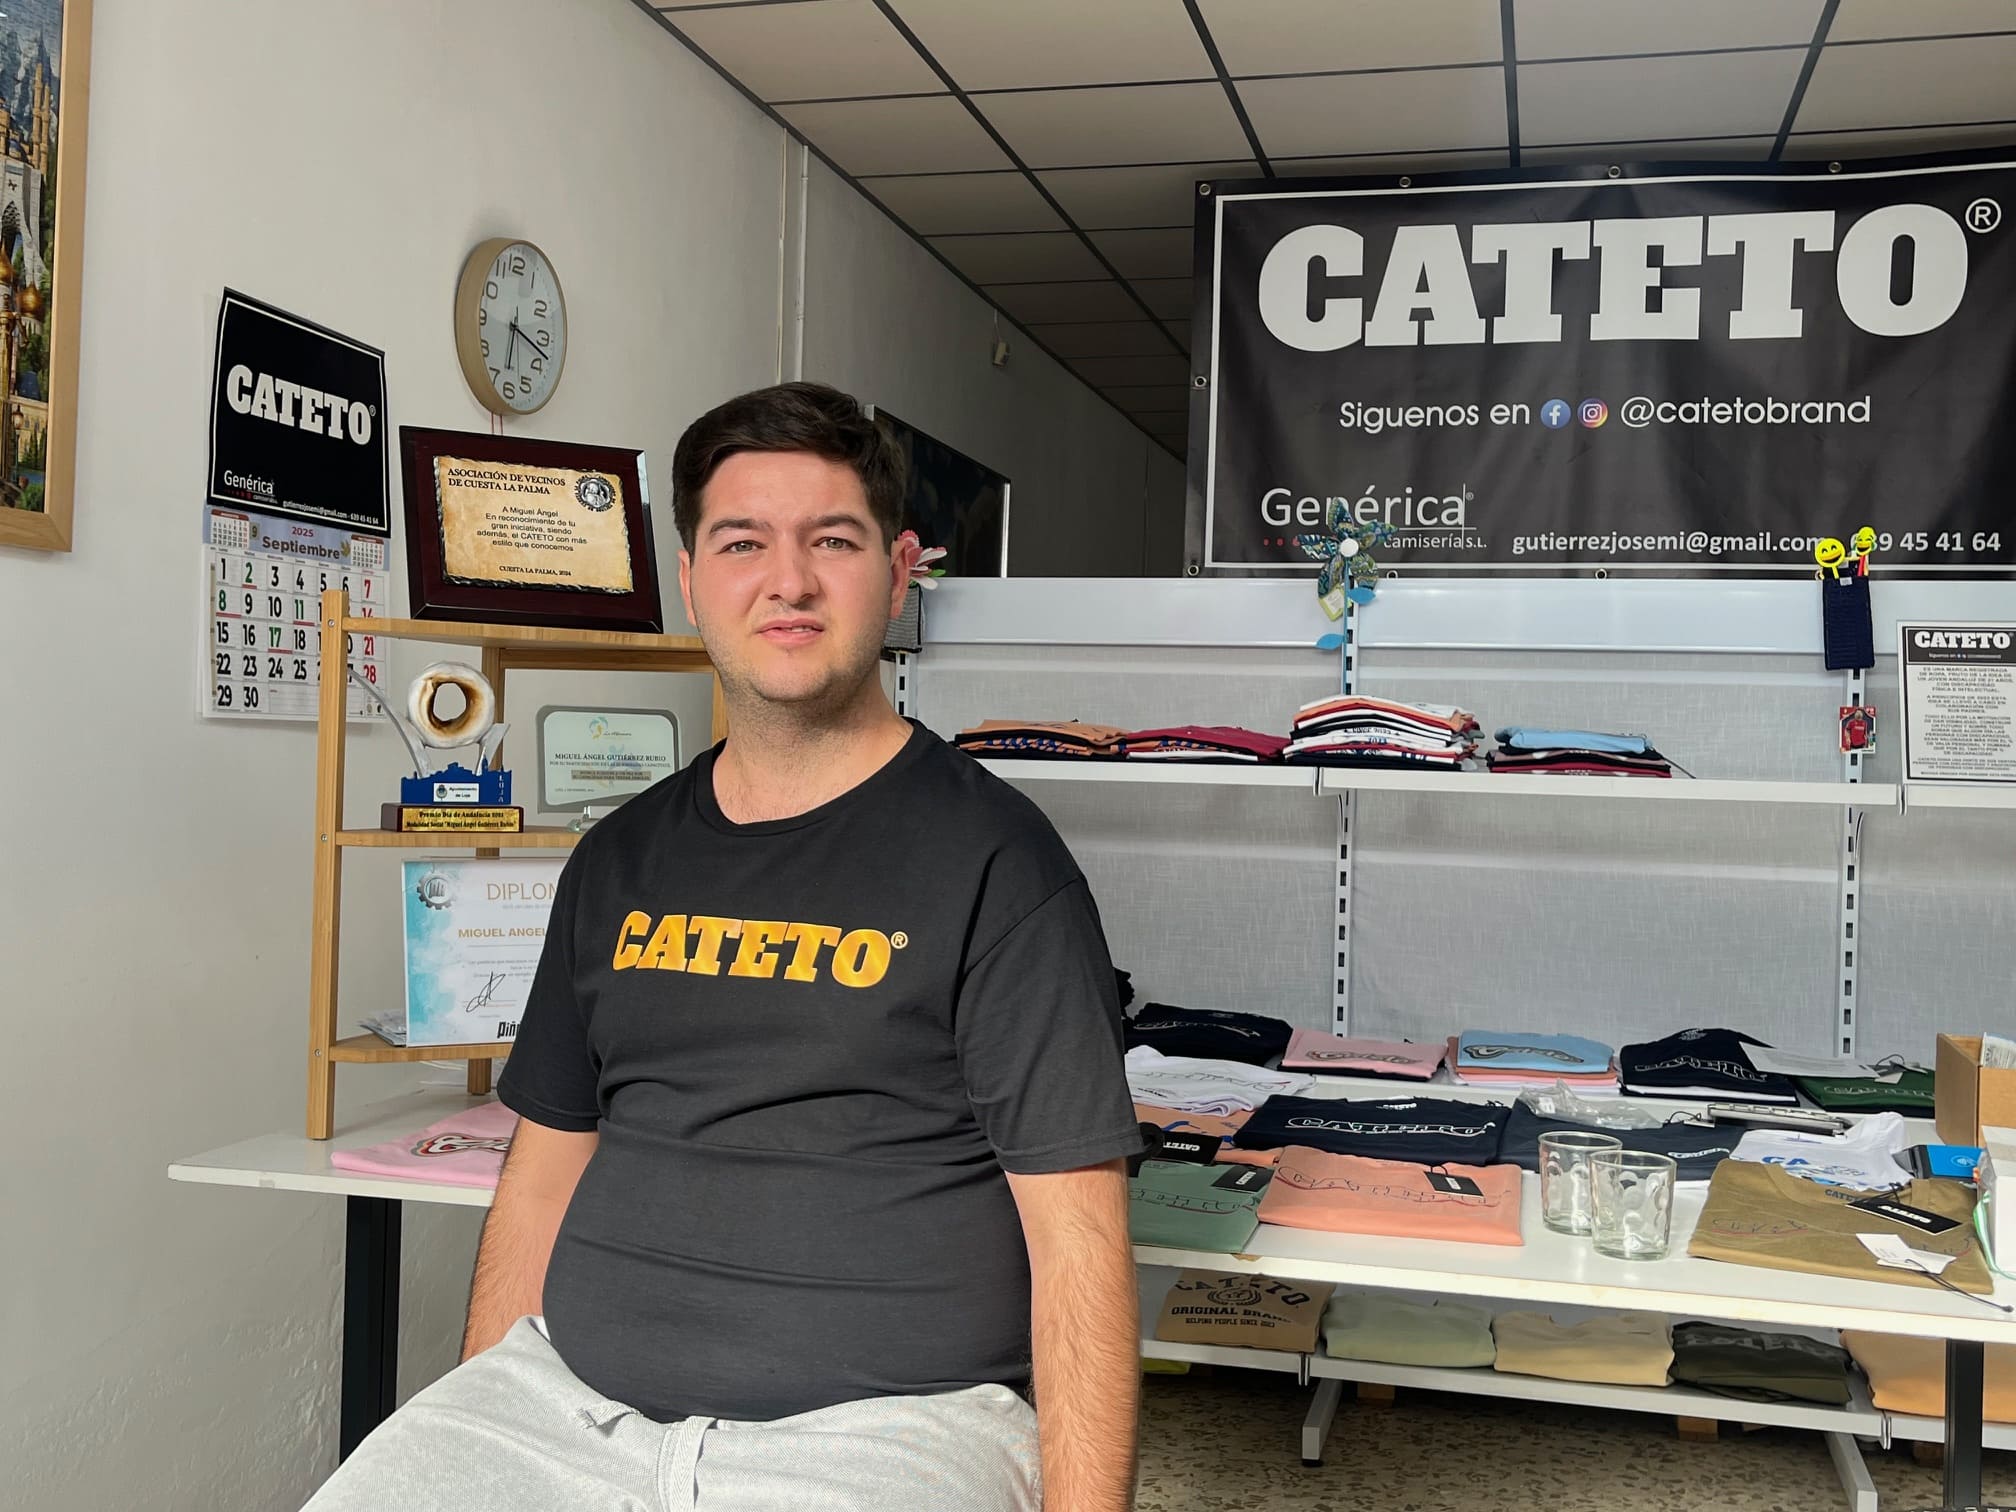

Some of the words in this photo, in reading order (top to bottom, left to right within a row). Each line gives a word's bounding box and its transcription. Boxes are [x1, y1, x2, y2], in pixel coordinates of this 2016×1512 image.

[509, 253, 526, 276] 12
[533, 299, 548, 319] 2
[536, 329, 550, 347] 3
[530, 357, 544, 375] 4
[502, 381, 516, 400] 6
[519, 376, 532, 395] 5
[1339, 399, 1480, 434] Siguenos
[1490, 404, 1530, 425] en
[1621, 395, 1872, 427] @catetobrand
[223, 470, 274, 495] Genérica
[448, 468, 507, 480] ASOCIACIÓN
[510, 473, 523, 482] DE
[524, 474, 566, 486] VECINOS
[448, 478, 462, 487] DE
[464, 479, 502, 490] CUESTA
[503, 483, 516, 492] LA
[518, 484, 551, 495] PALMA
[498, 515, 555, 525] reconocimiento
[510, 506, 535, 516] Miguel
[536, 507, 559, 518] Ángel
[292, 526, 314, 538] 2025
[520, 532, 554, 541] CATETO
[547, 527, 572, 535] siendo
[262, 536, 340, 560] Septiembre
[492, 539, 513, 547] estilo
[531, 543, 574, 551] conocemos
[1901, 532, 1931, 551] 45
[1936, 532, 1964, 551] 41
[1972, 532, 2002, 551] 64
[221, 558, 226, 580] 1
[245, 562, 253, 583] 2
[271, 566, 279, 587] 3
[296, 569, 304, 590] 4
[320, 573, 327, 593] 5
[364, 579, 371, 599] 7
[219, 590, 227, 611] 8
[245, 593, 253, 614] 9
[268, 596, 282, 618] 10
[294, 599, 304, 620] 11
[217, 622, 229, 643] 15
[243, 624, 256, 646] 16
[269, 626, 282, 648] 17
[294, 629, 306, 650] 18
[364, 636, 374, 656] 21
[217, 653, 231, 675] 22
[243, 655, 257, 677] 23
[268, 657, 283, 679] 24
[293, 659, 307, 680] 25
[363, 665, 377, 684] 28
[217, 685, 232, 707] 29
[243, 686, 259, 708] 30
[458, 928, 505, 938] MIGUEL
[1163, 1141, 1200, 1152] CATET
[1171, 1305, 1238, 1315] ORIGINAL
